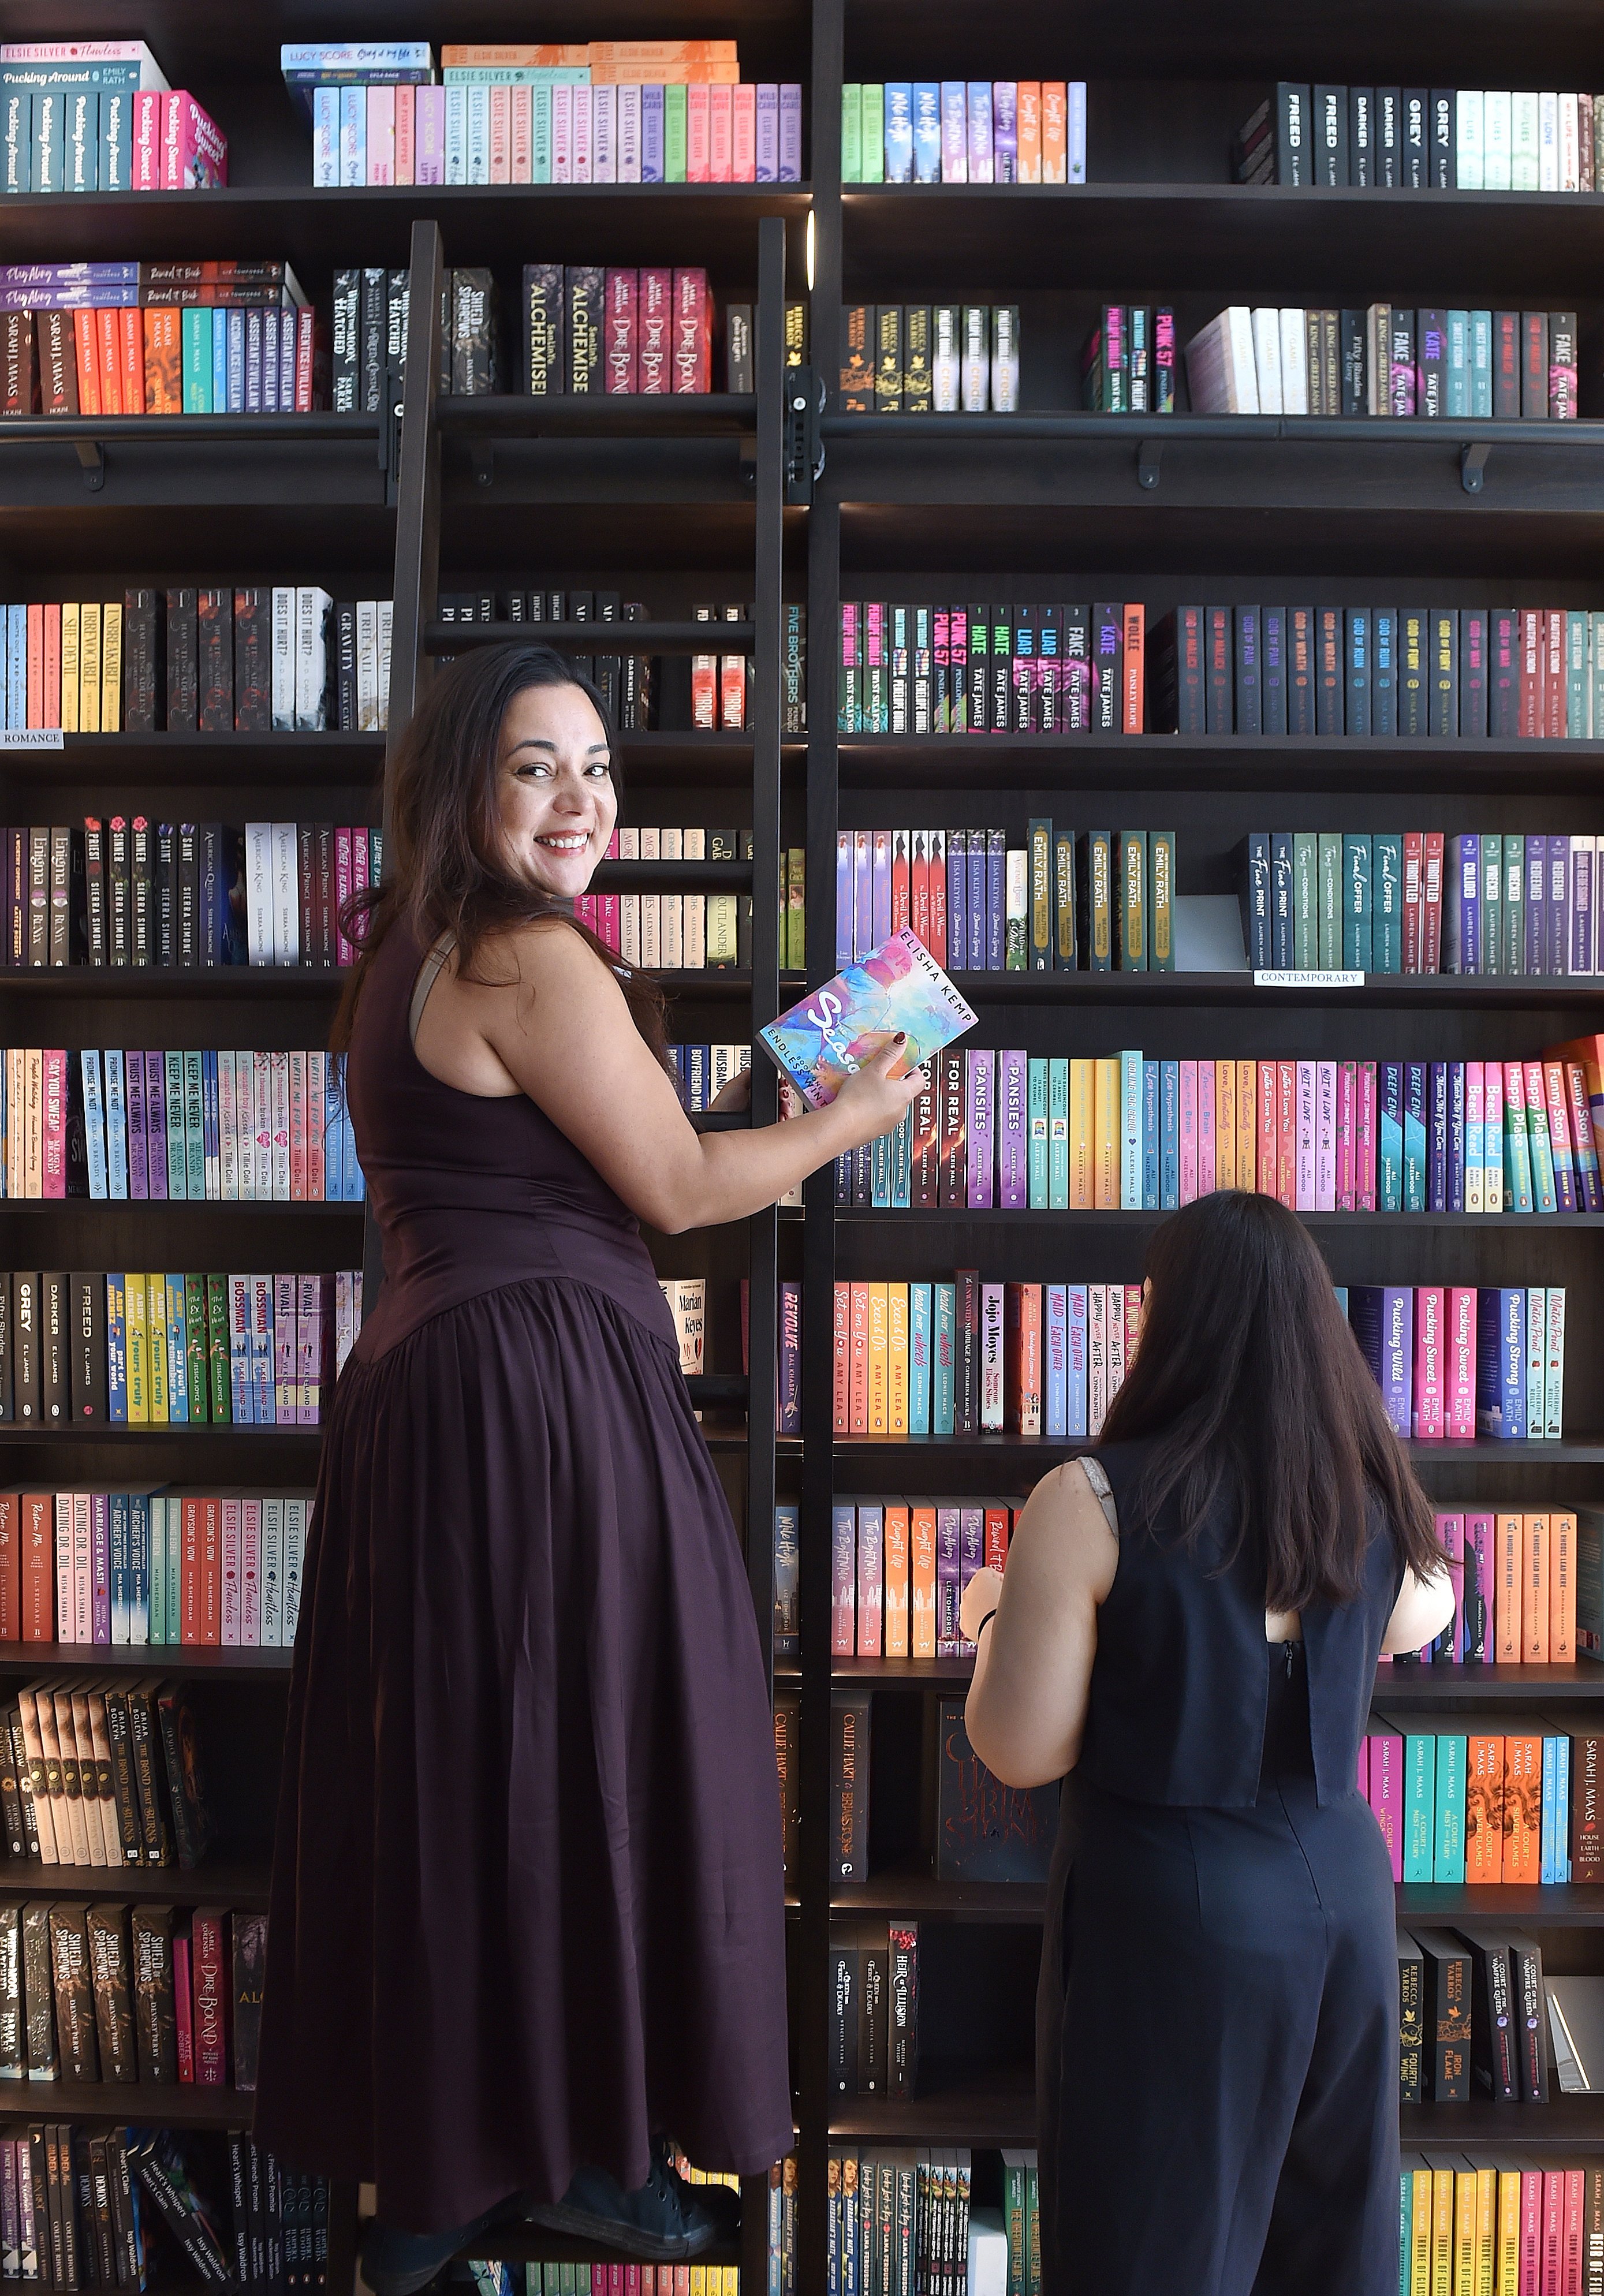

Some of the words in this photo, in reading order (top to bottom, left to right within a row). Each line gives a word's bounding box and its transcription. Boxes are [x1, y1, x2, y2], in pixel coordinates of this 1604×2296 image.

[6, 49, 31, 58] ELSIE
[36, 48, 65, 57] SILVER
[290, 52, 317, 61] LUCY
[320, 51, 353, 60] SCORE
[3, 70, 47, 86] Pucking
[48, 70, 90, 83] Around
[103, 76, 125, 84] RATH
[138, 96, 153, 146] Pucking
[1288, 95, 1301, 148] FREED
[1357, 97, 1367, 148] DARKER
[1436, 99, 1449, 147] GREY
[140, 146, 152, 182] Sweet
[301, 313, 312, 359] APPRENTICE
[1156, 315, 1173, 349] PUNK
[1394, 332, 1409, 361] FAKE
[1156, 350, 1173, 367] 57
[276, 594, 288, 615] DOES
[788, 606, 799, 634] FIVE
[84, 611, 97, 688] IRREVOCABLE
[106, 610, 120, 686] UNBREAKABLE
[277, 627, 288, 656] HURT?
[341, 612, 352, 671] GRAVITY
[972, 625, 987, 655] HATE
[1017, 629, 1032, 656] LIAR
[1101, 625, 1115, 655] KATE
[787, 636, 799, 704] BROTHERS
[973, 668, 983, 690] TATE
[695, 686, 713, 730] CORRUPT
[973, 693, 982, 727] JAMES
[4, 733, 60, 744] ROMANCE
[31, 837, 48, 886] Enigma
[88, 832, 100, 861] PRIEST
[113, 832, 125, 863] SINNER
[182, 838, 193, 863] SAINT
[1034, 835, 1044, 869] EMILY
[1251, 859, 1269, 887] Fine
[1349, 845, 1367, 884] Final
[1034, 871, 1044, 901] RATH
[1406, 859, 1419, 904] THROTTLED
[1464, 863, 1476, 899] COLLIDED
[1486, 864, 1499, 901] WRECKED
[91, 882, 100, 914] SIERRA
[1256, 890, 1265, 917] PRINT
[1353, 882, 1363, 913] OFFER
[92, 918, 101, 950] SIMONE
[717, 897, 728, 955] OUTLANDER
[898, 931, 939, 982] ELISHA
[941, 985, 972, 1022] KEMP
[1261, 972, 1357, 983] CONTEMPORARY
[836, 1020, 848, 1035] THE
[767, 1028, 805, 1076] ENDLESS
[49, 1058, 60, 1080] SAY
[87, 1056, 95, 1084] PROMISE
[128, 1058, 139, 1083] TRUST
[691, 1049, 702, 1095] BOYFRIEND
[716, 1050, 727, 1090] HUSBAND
[812, 1077, 823, 1091] ONE
[948, 1061, 960, 1092] FOR
[1127, 1056, 1136, 1091] LOOKING
[1301, 1067, 1311, 1084] NOT
[50, 1079, 60, 1099] YOU
[88, 1086, 95, 1096] ME
[129, 1085, 140, 1095] ME
[975, 1066, 987, 1130] PANSIES
[1128, 1092, 1136, 1106] FOR
[1301, 1087, 1311, 1095] IN
[1509, 1069, 1521, 1106] Happy
[1549, 1068, 1562, 1106] Funny
[49, 1100, 60, 1132] SWEAR
[130, 1098, 141, 1134] ALWAYS
[948, 1096, 960, 1136] REAL
[1301, 1098, 1311, 1119] LOVE
[1468, 1085, 1478, 1122] Beach
[1468, 1125, 1478, 1156] Read
[1511, 1108, 1523, 1148] Place
[1552, 1108, 1565, 1144] Story
[20, 1284, 31, 1332] GREY
[83, 1285, 91, 1338] FREED
[234, 1281, 246, 1334] BOSSMAN
[679, 1293, 702, 1312] Marian
[988, 1295, 1000, 1323] Jojo
[685, 1317, 702, 1336] Keyes
[785, 1292, 798, 1350] REVOLVE
[1423, 1294, 1438, 1346] Pucking
[130, 1340, 140, 1372] yours
[988, 1326, 1001, 1364] Moyes
[1426, 1347, 1438, 1383] Sweet
[133, 1375, 141, 1406] truly
[1431, 1398, 1439, 1422] EMILY
[58, 1499, 69, 1532] DATING
[187, 1504, 196, 1544] GRAYSON'S
[226, 1504, 236, 1531] ELSIE
[58, 1536, 68, 1552] DR.
[188, 1545, 196, 1561] VOW
[226, 1534, 236, 1568] SILVER
[58, 1555, 69, 1570] DIL
[225, 1581, 237, 1625] Flawless
[110, 1707, 120, 1741] BOLEYN
[118, 1711, 126, 1736] BRIAR
[118, 1760, 129, 1784] BOND
[1586, 1740, 1596, 1776] SARAH
[121, 1787, 129, 1804] THAT
[1585, 1779, 1596, 1787] J.
[1585, 1789, 1596, 1821] MAAS
[122, 1806, 135, 1843] BURNS
[56, 1929, 70, 1980] SPARROWS
[69, 1933, 81, 1968] SHIELD
[202, 1962, 217, 1993] DIRE
[894, 1955, 908, 1988] HEIR
[1492, 1958, 1501, 1988] VAMPIRE
[895, 1987, 908, 2028] ILLUSION
[1494, 1989, 1502, 2014] QUEEN
[199, 1993, 218, 2044] BOUND
[1400, 2058, 1409, 2081] WING
[1409, 2052, 1418, 2087] FOURTH
[233, 2172, 241, 2208] Whispers
[1590, 2234, 1603, 2257] HEIR
[1590, 2260, 1603, 2275] OF
